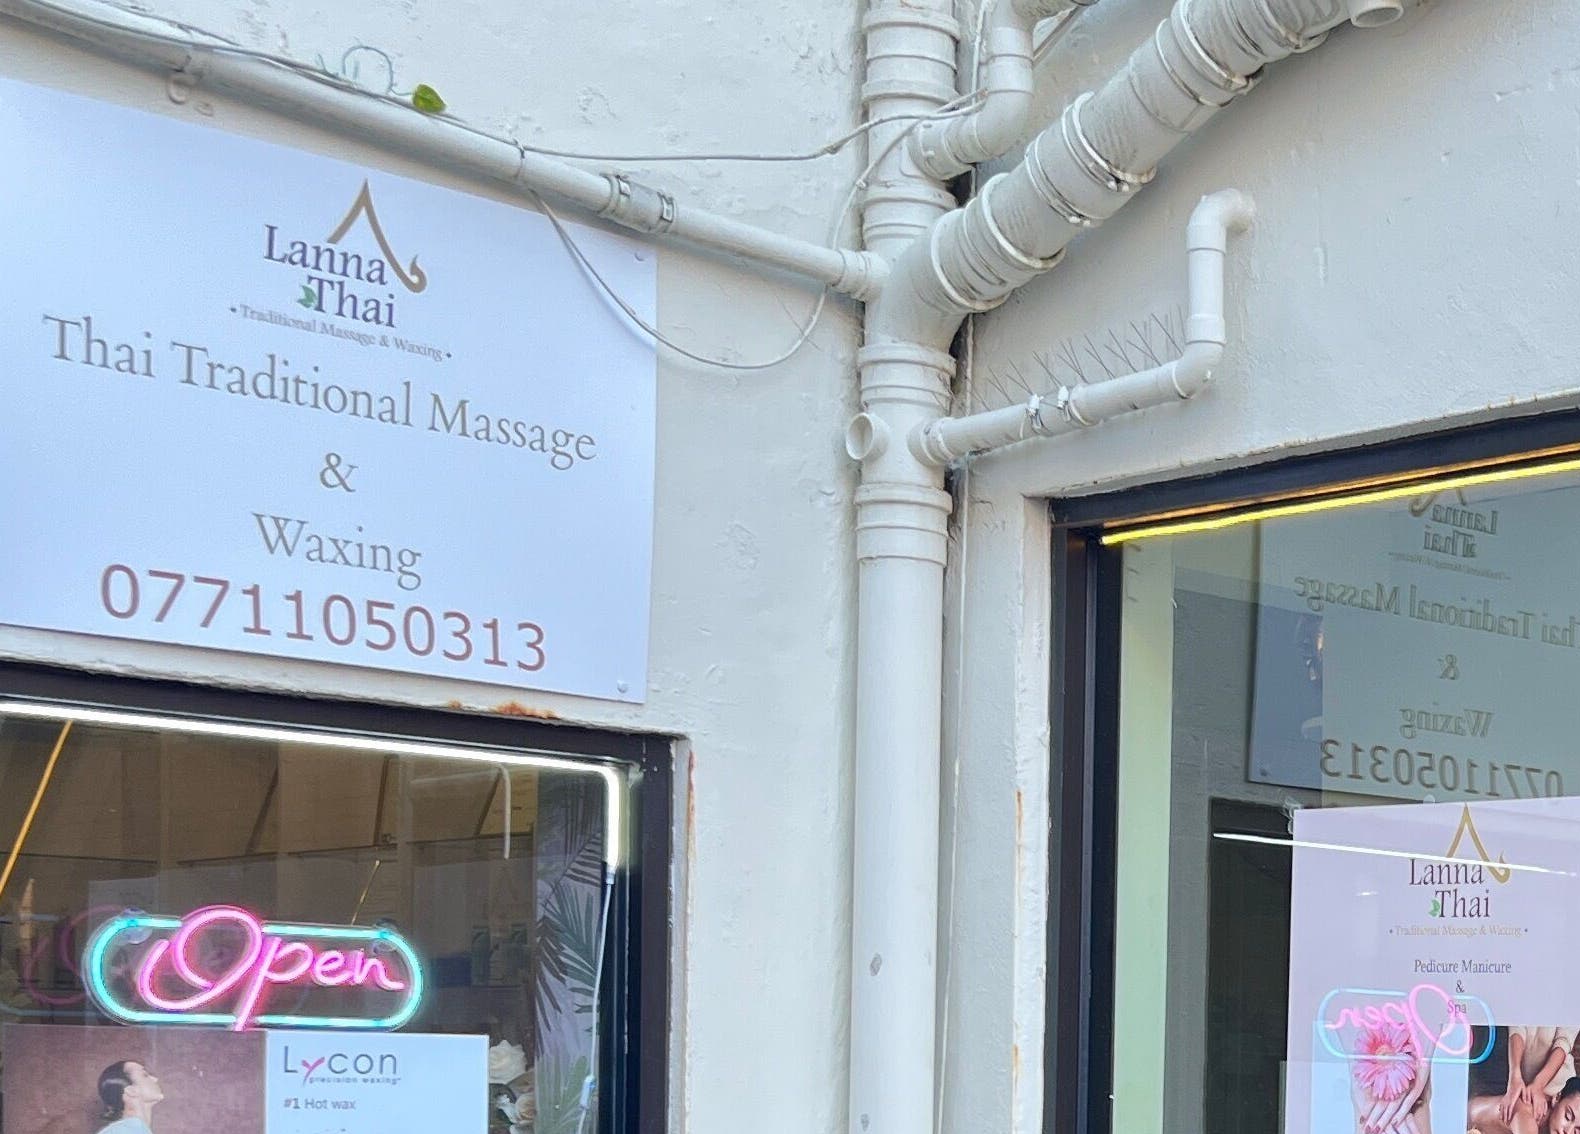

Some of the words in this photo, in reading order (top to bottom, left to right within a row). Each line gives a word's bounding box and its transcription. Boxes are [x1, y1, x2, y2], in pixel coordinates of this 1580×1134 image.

[264, 224, 387, 286] Lanna
[308, 275, 396, 328] Thai
[240, 304, 317, 332] Traditional
[321, 322, 375, 346] Massage
[379, 335, 390, 347] &
[393, 337, 442, 361] Waxing
[42, 314, 155, 378] Thai
[171, 340, 412, 427] Traditional
[428, 393, 597, 470] Massage
[319, 452, 358, 492] &
[252, 511, 422, 591] Waxing
[100, 563, 547, 672] 07711050313
[1409, 858, 1486, 885] Lanna
[1435, 888, 1491, 918] Thai
[139, 904, 406, 1031] Open
[1414, 959, 1459, 974] Pedicure
[1461, 959, 1512, 974] Manicure
[1455, 980, 1465, 993] &
[1447, 1000, 1467, 1017] Spa
[284, 1046, 397, 1087] Lycon
[284, 1098, 300, 1110] #1
[304, 1098, 328, 1110] Hot
[331, 1100, 356, 1110] wax
